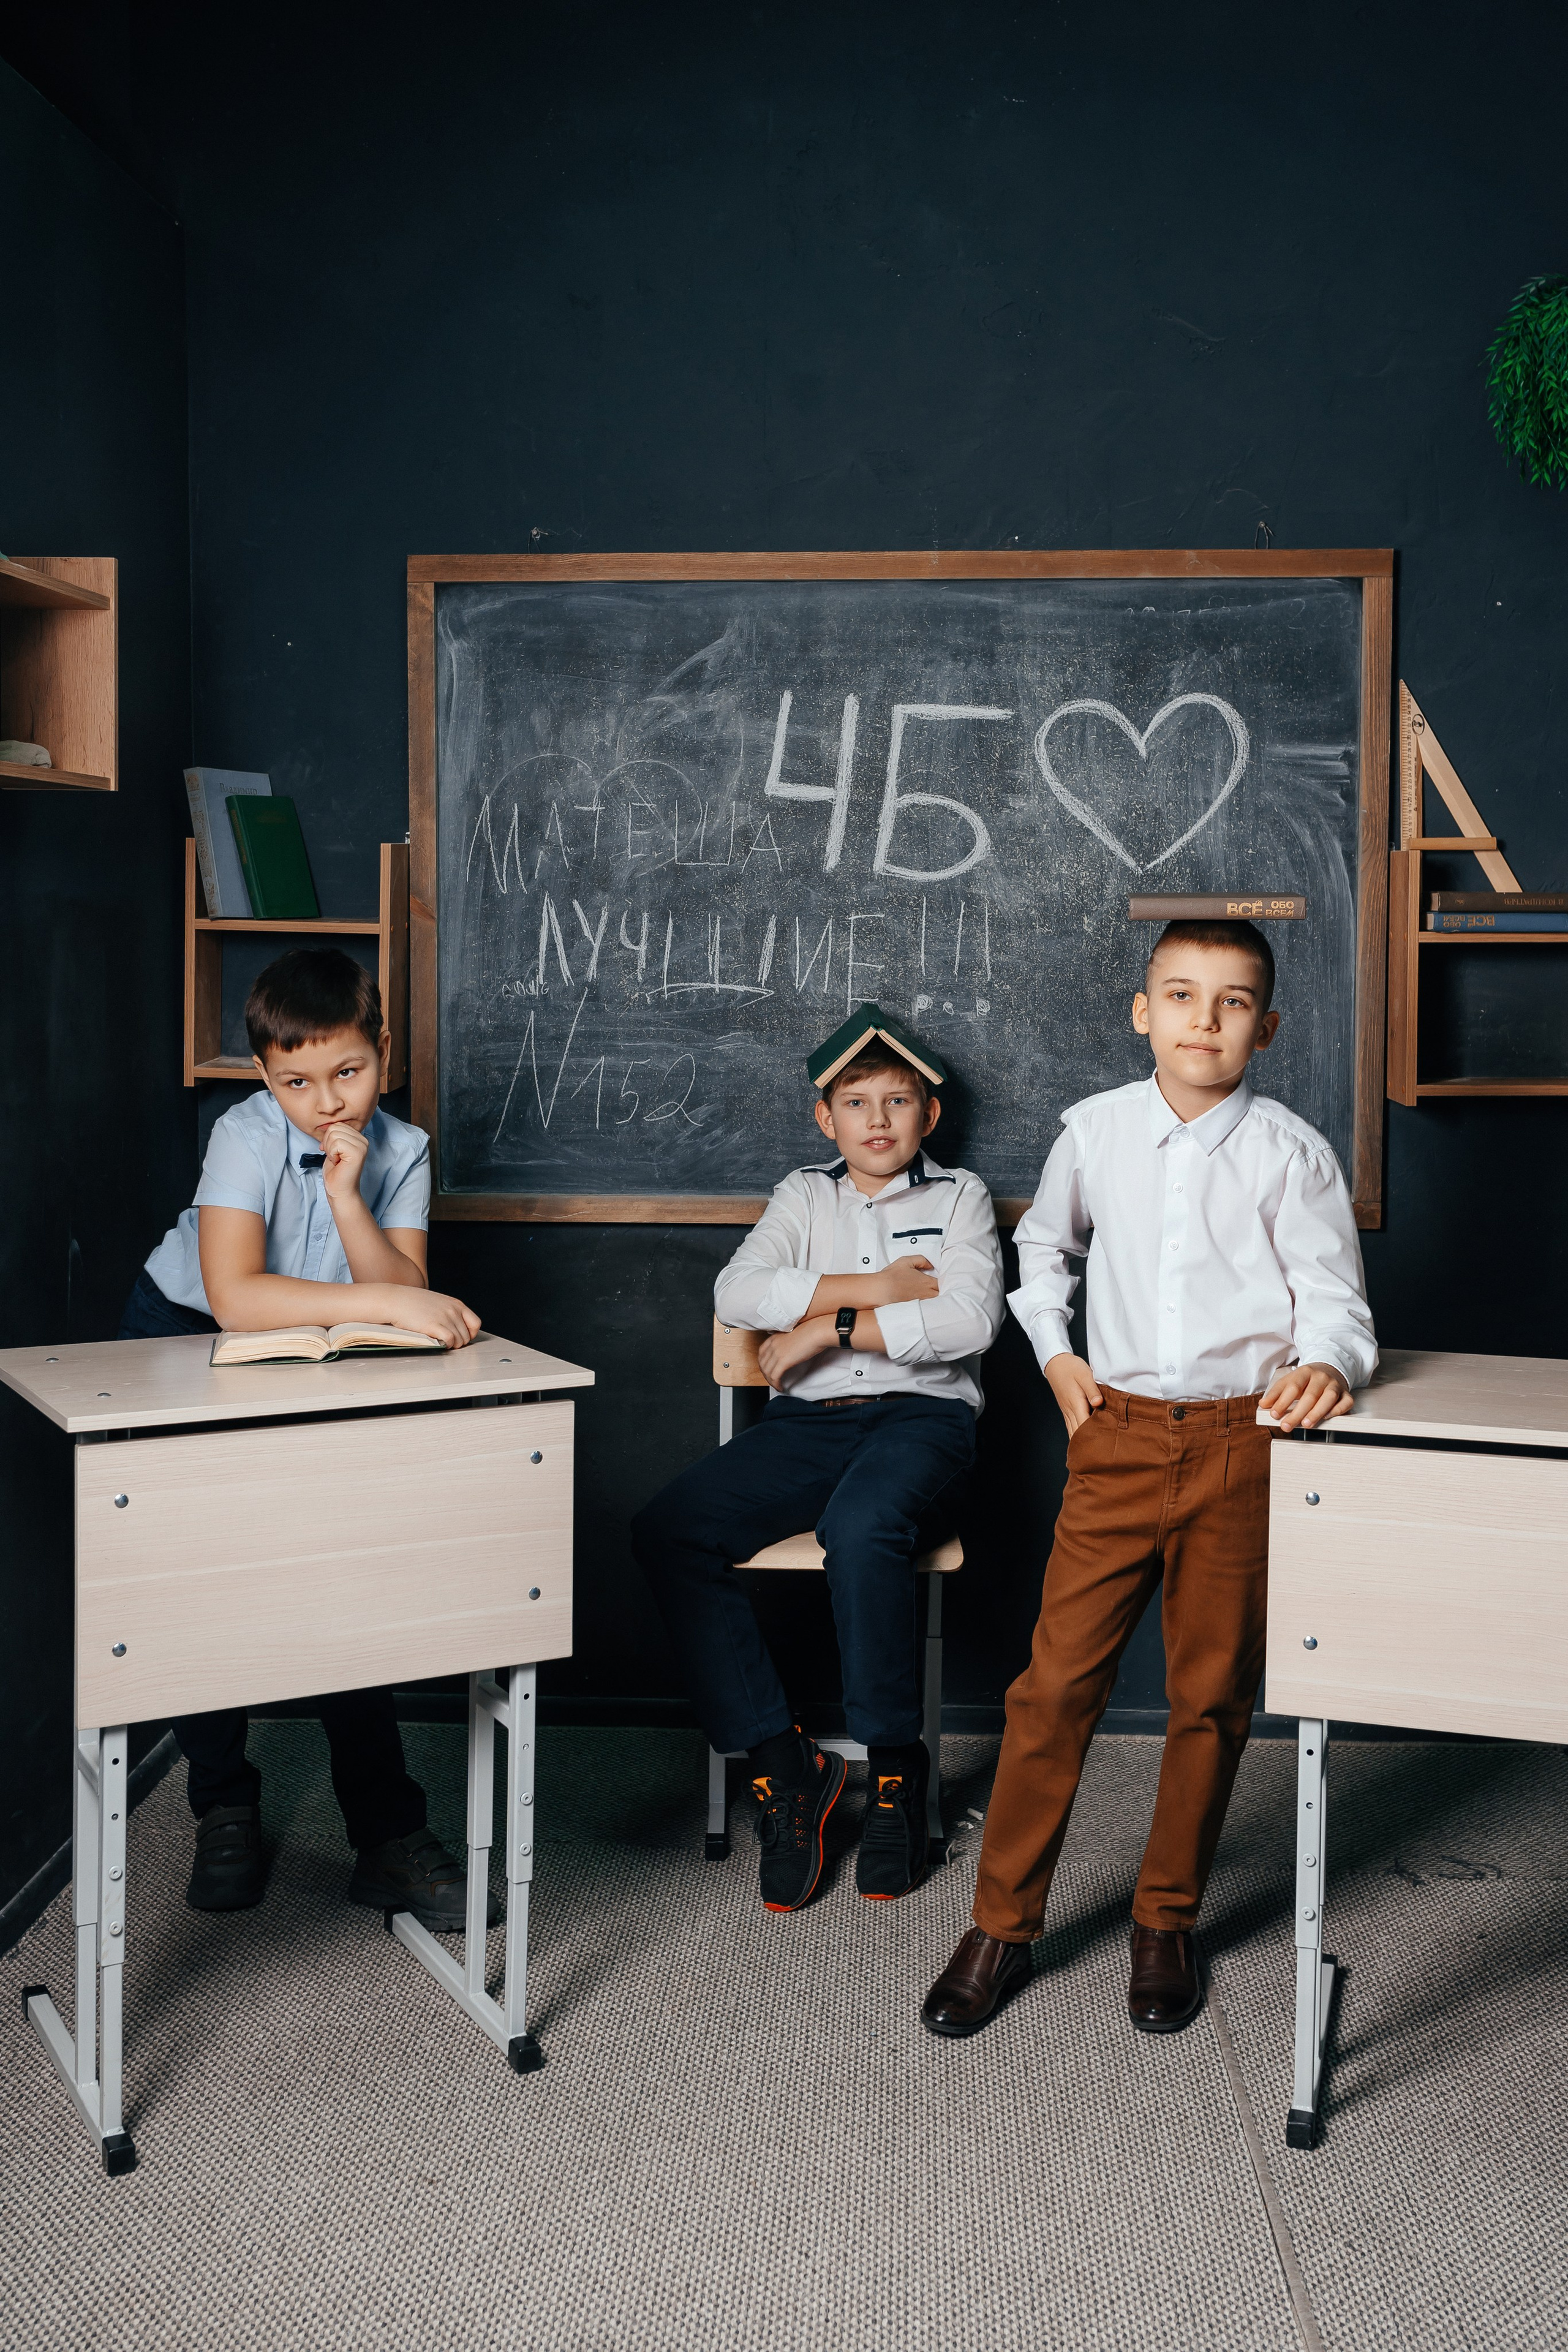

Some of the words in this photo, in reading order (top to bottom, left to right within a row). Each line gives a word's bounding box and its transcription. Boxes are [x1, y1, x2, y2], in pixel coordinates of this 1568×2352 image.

[765, 690, 1016, 882] 4Б
[1271, 900, 1294, 909] ОБО
[1265, 909, 1294, 918] ВСЕМ
